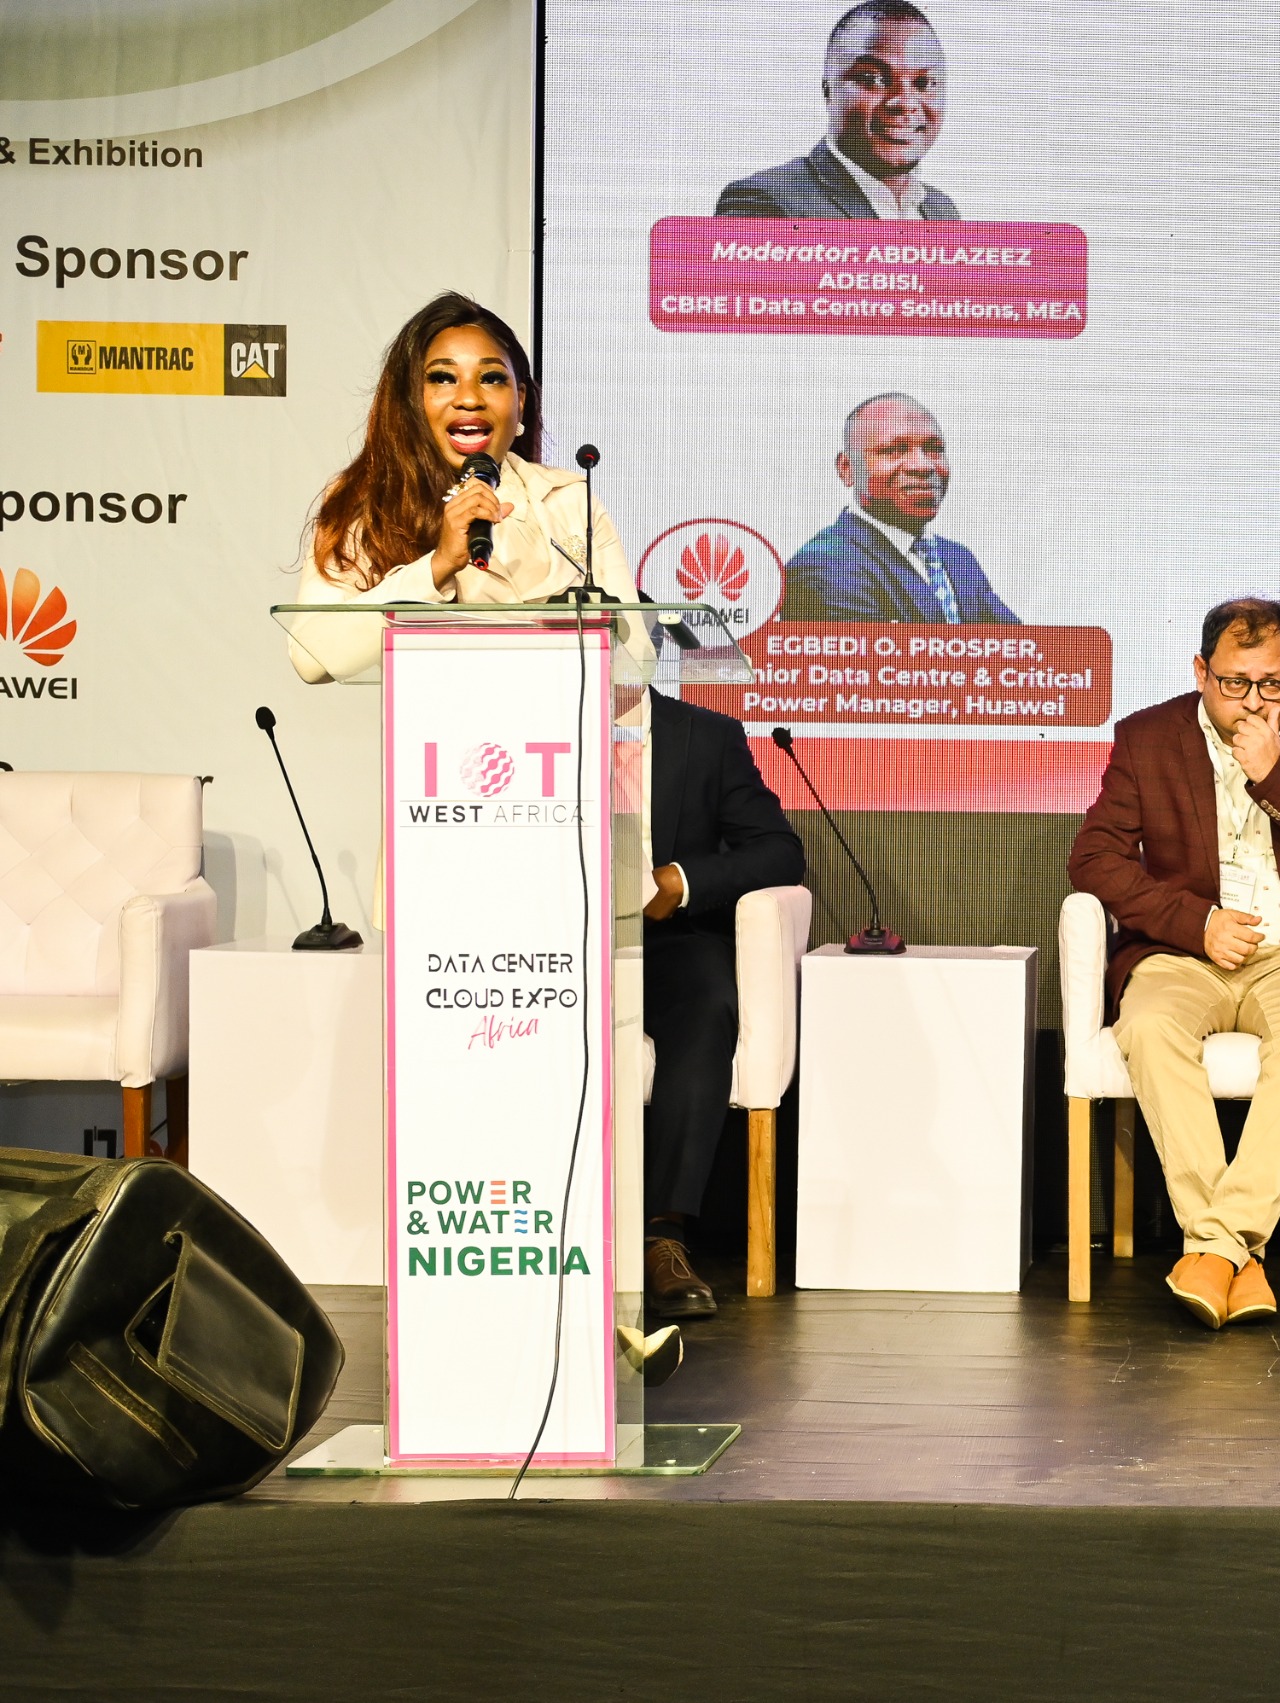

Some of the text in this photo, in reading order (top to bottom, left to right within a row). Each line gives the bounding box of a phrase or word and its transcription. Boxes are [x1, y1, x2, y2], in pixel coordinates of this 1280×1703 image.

[29, 137, 203, 168] Exhibition
[15, 234, 249, 288] Sponsor
[712, 241, 1032, 266] Moderator: ABDULAZEEZ
[818, 272, 925, 293] ADEBISI,
[661, 298, 727, 315] CBRE
[749, 298, 805, 316] Data
[812, 298, 893, 318] Centre
[901, 299, 1020, 321] Solutions,
[1026, 302, 1082, 320] MEA
[100, 342, 279, 378] MANTRAC CAT
[767, 635, 1044, 661] EGBEDI O. PROSPER,
[809, 666, 870, 686] Data
[877, 667, 965, 689] Centre
[973, 668, 992, 688] &
[999, 667, 1092, 690] Critical
[743, 692, 1066, 719] Power Manager, Huawei
[409, 805, 584, 823] WEST AFRICA
[428, 954, 573, 973] DATA CENTER
[426, 988, 577, 1009] CLOUD EXPO
[468, 1014, 539, 1050] Africa
[407, 1180, 532, 1205] POWER
[406, 1210, 554, 1235] & WATER
[408, 1246, 591, 1277] NIGERIA
